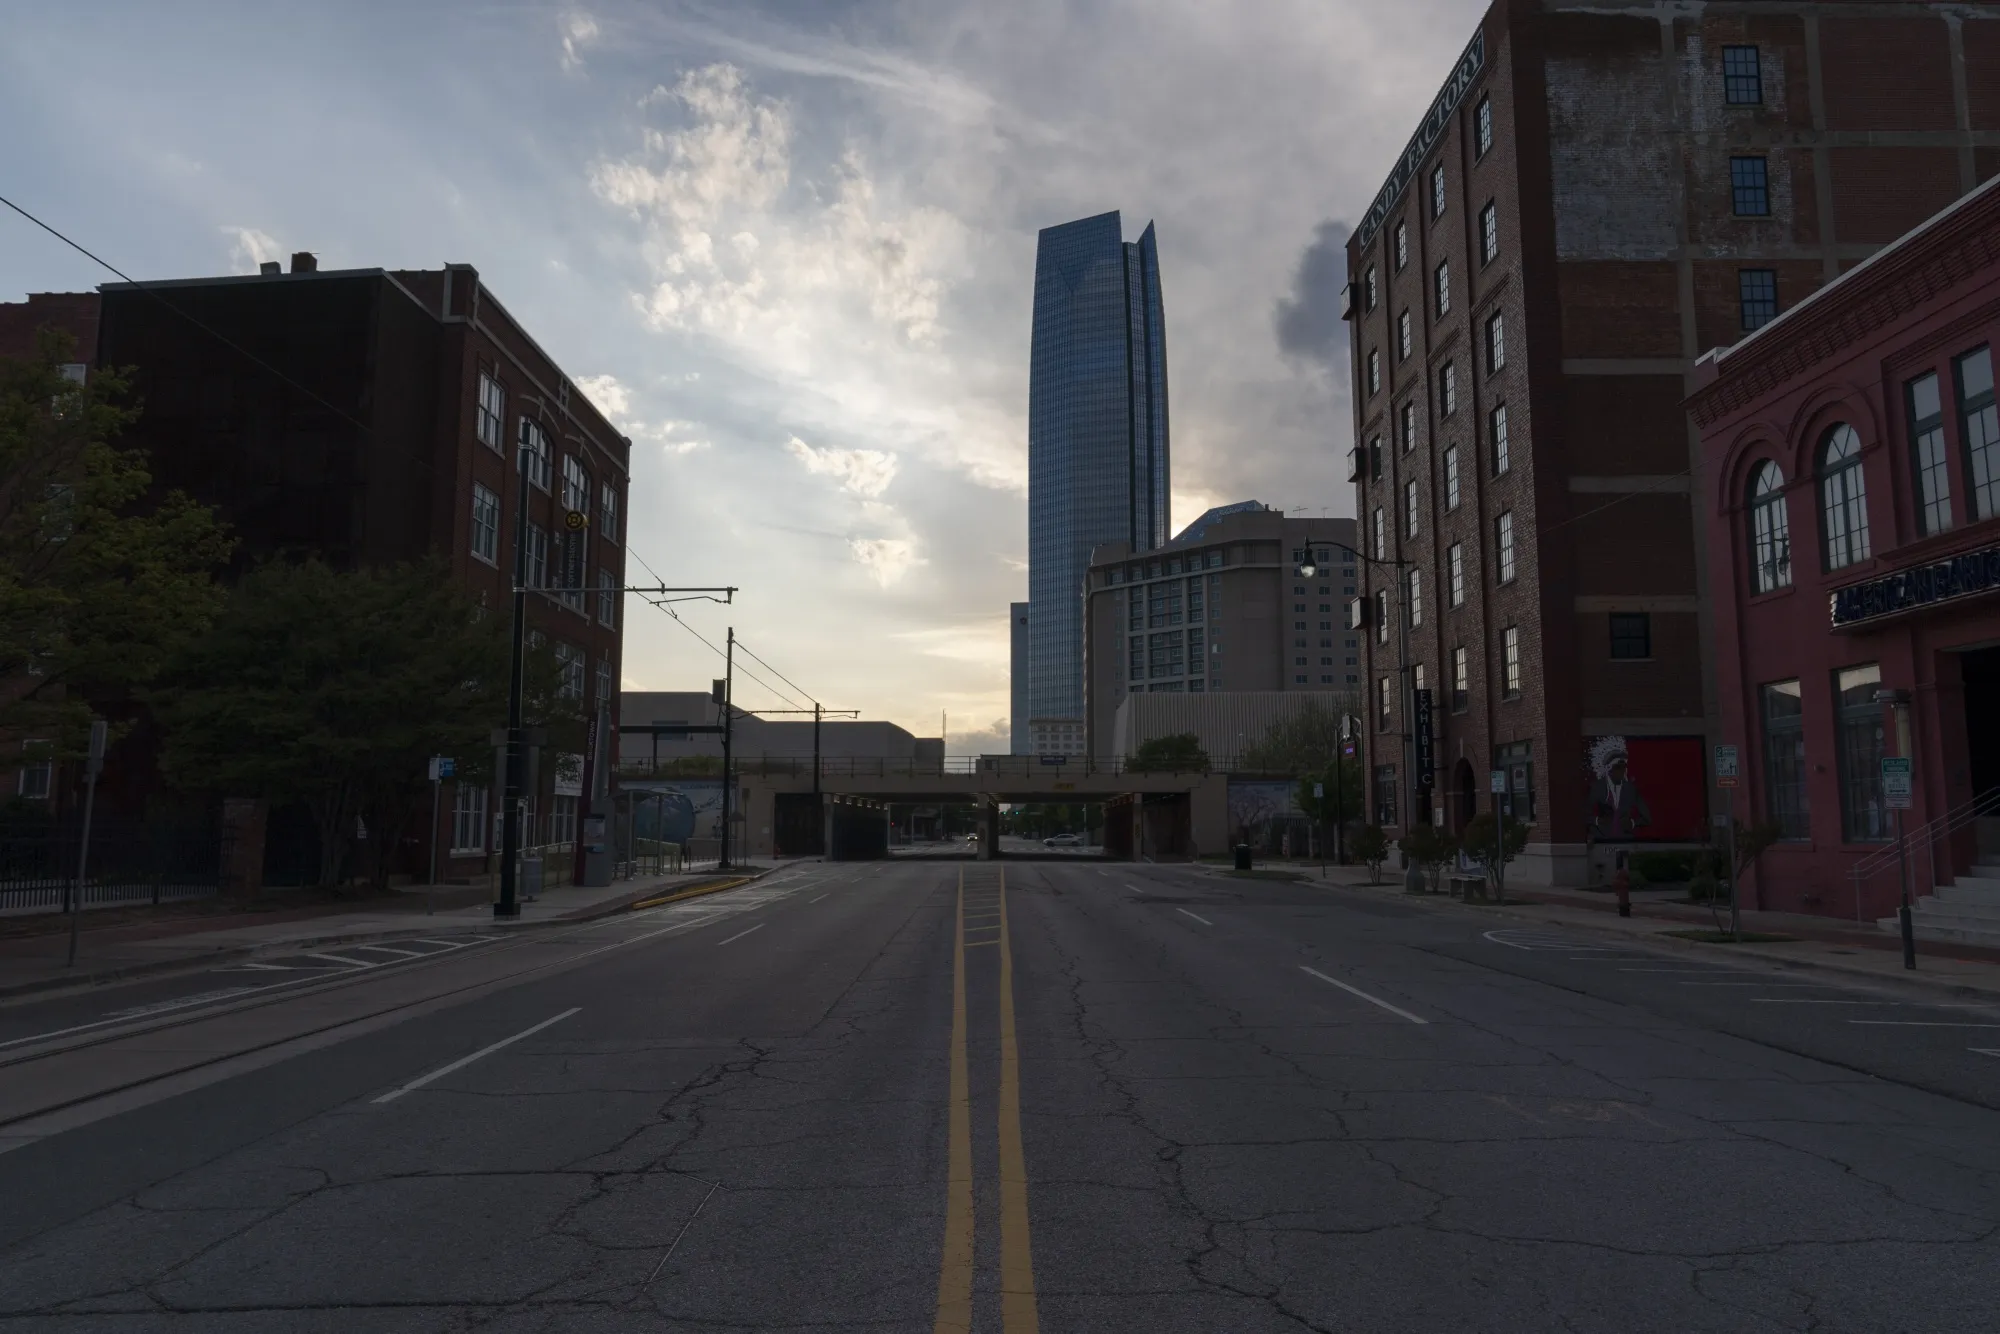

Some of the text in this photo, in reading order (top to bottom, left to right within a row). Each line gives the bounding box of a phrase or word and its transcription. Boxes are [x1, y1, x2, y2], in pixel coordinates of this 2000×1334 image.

[1360, 38, 1483, 247] CANDY FACTORY
[1834, 566, 1934, 623] AMERICAN
[1419, 691, 1430, 768] EXHIBIT
